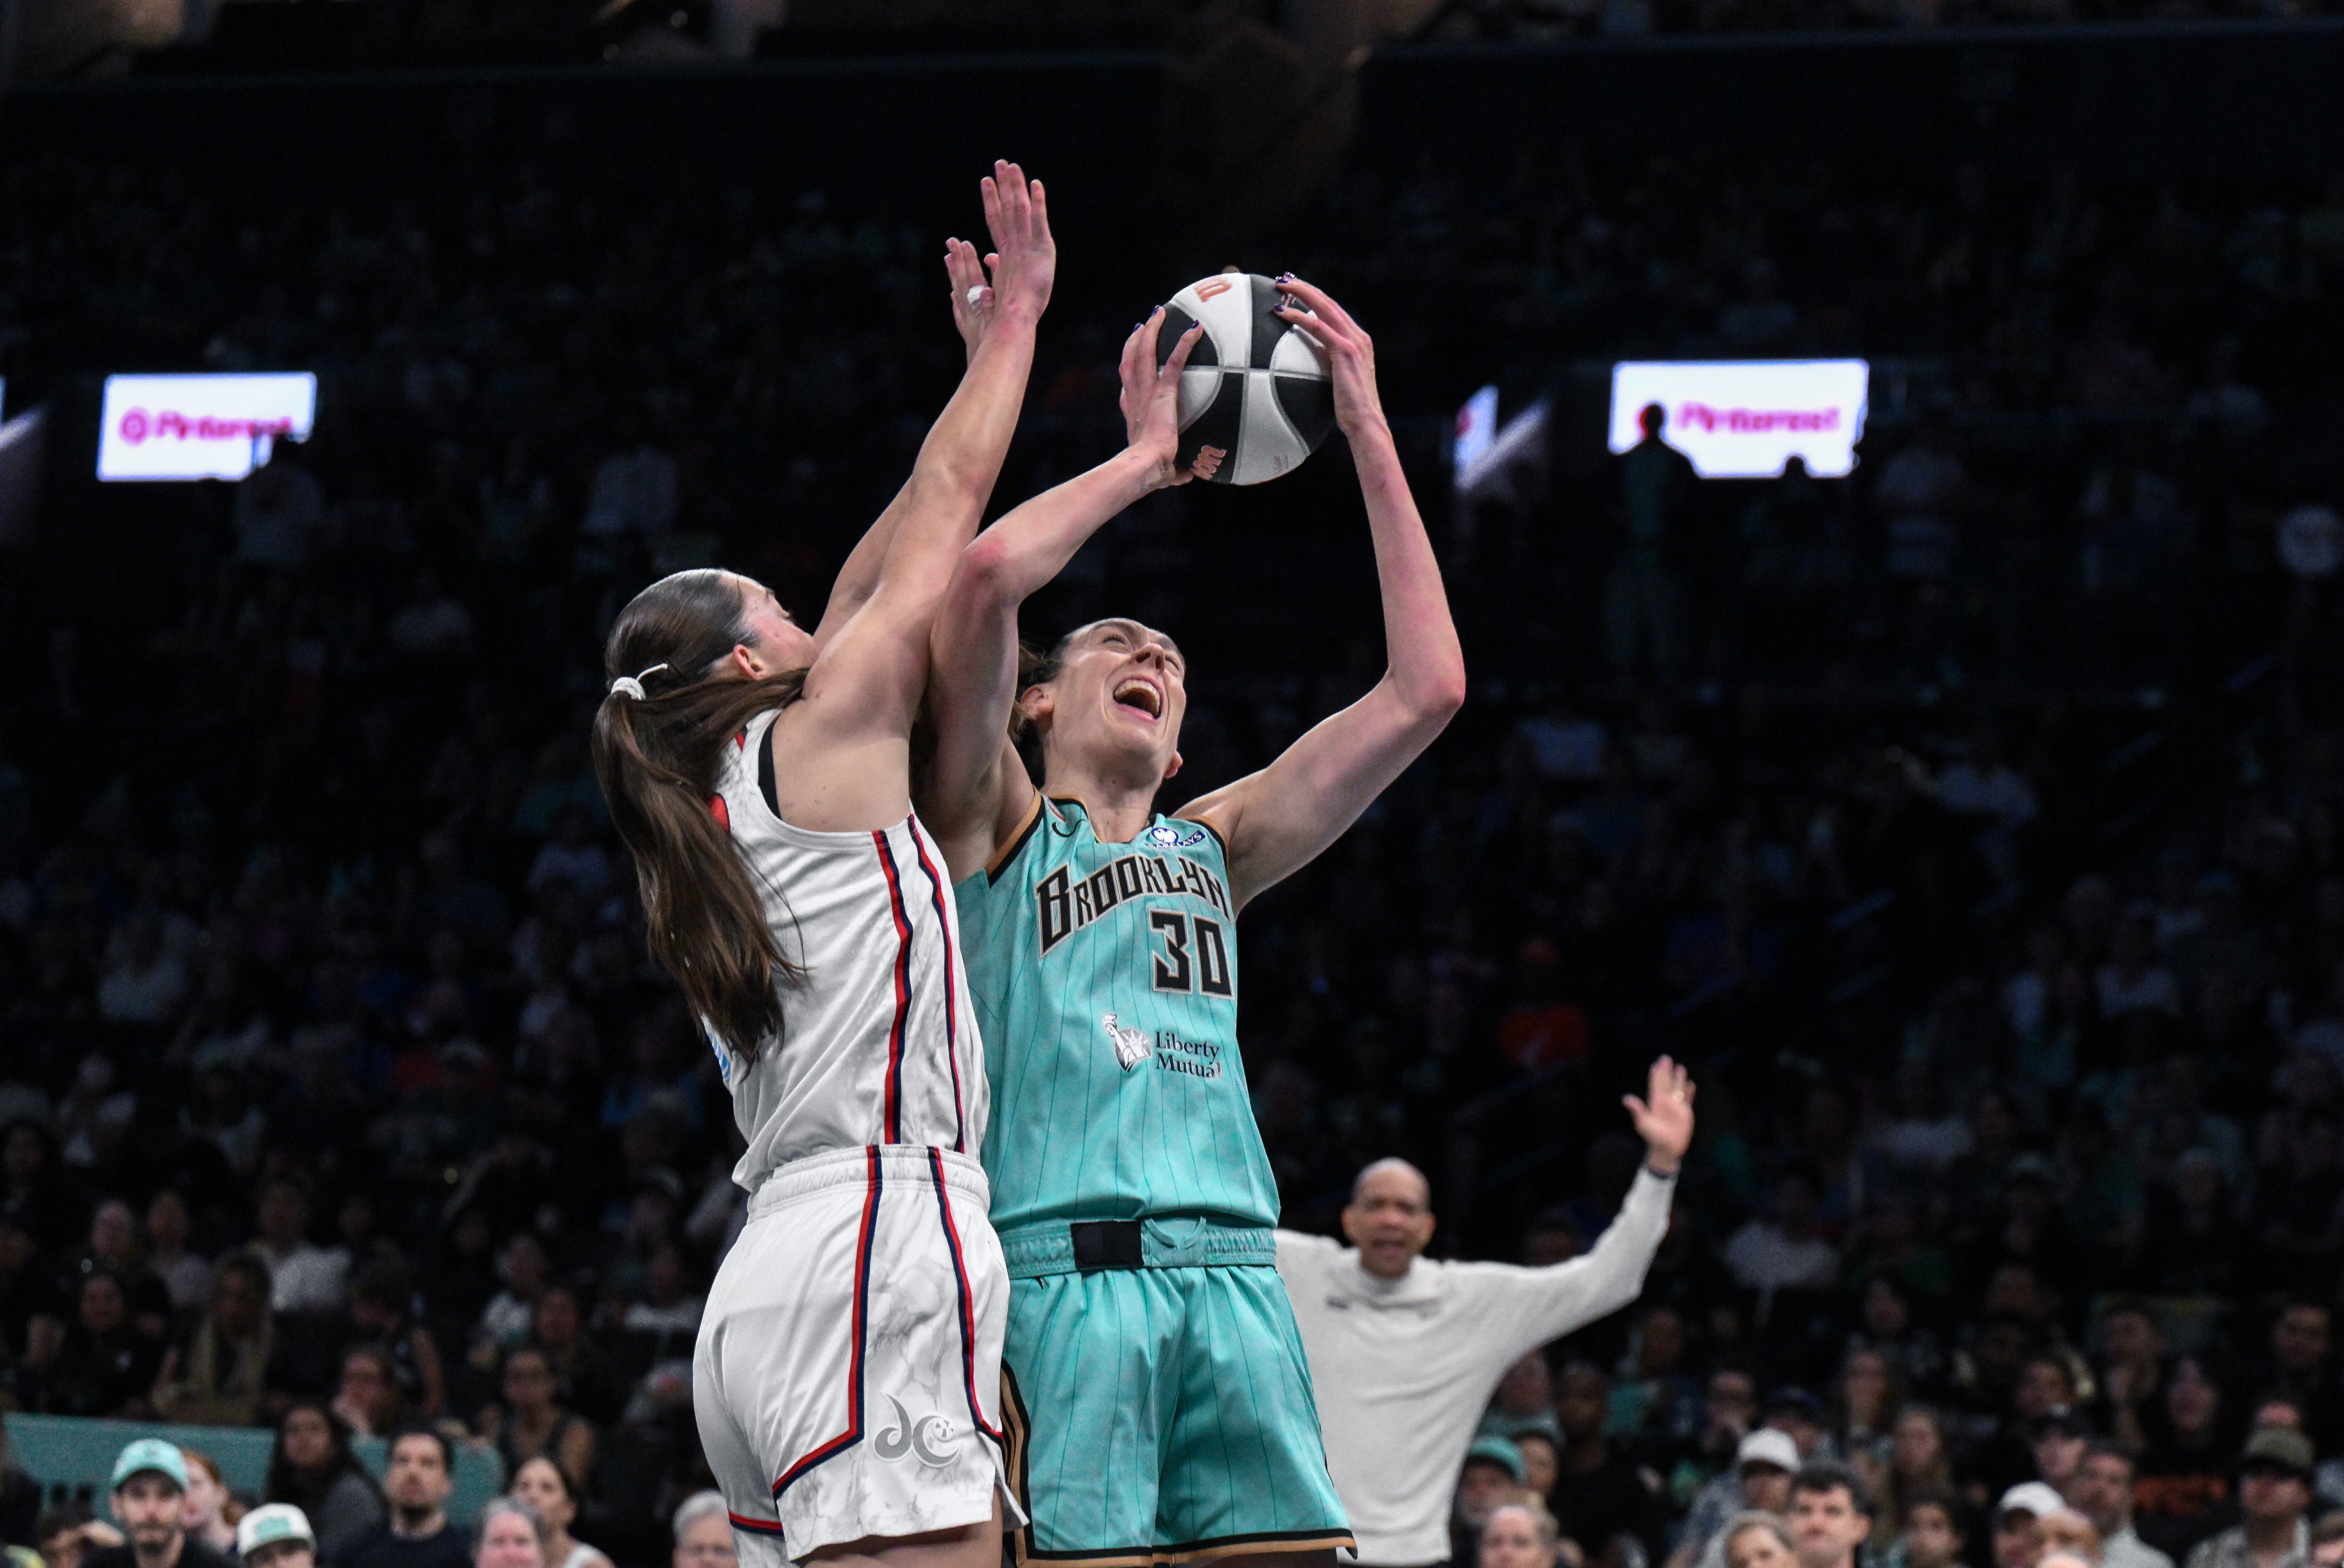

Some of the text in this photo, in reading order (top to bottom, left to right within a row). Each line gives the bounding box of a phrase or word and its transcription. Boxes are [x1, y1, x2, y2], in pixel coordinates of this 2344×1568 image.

[1149, 909, 1234, 999] 30
[1155, 1031, 1220, 1065] Liberty
[1156, 1052, 1222, 1078] Mutual
